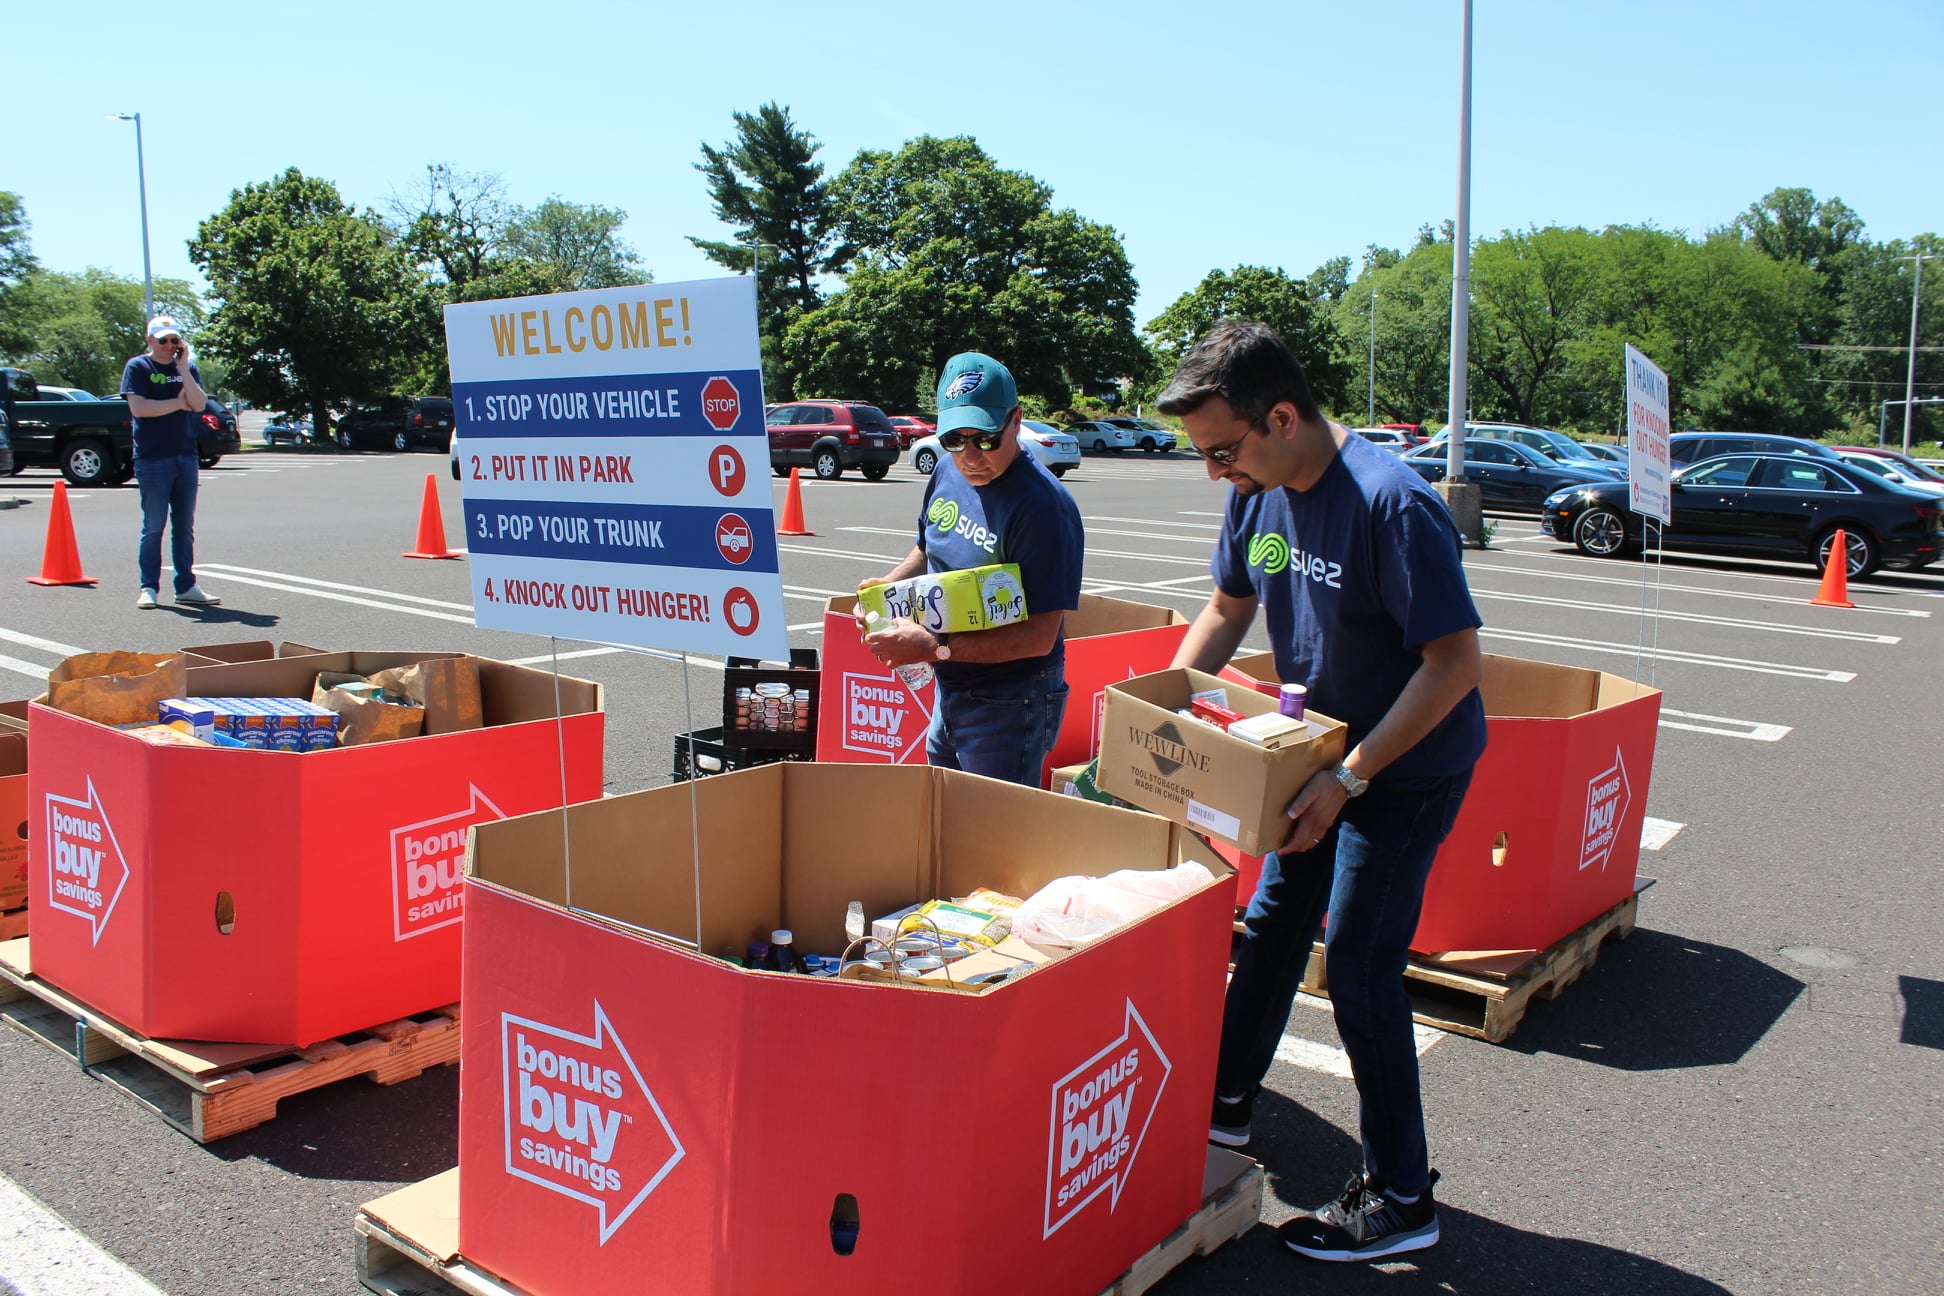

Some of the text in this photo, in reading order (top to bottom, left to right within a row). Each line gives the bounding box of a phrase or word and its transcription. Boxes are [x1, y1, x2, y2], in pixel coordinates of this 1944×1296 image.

[490, 297, 692, 357] WELCOME!
[166, 375, 183, 383] sue
[1632, 358, 1656, 401] THANK
[465, 389, 680, 421] 1. STOP YOUR VEHICLE
[706, 398, 736, 412] STOP
[1633, 401, 1645, 426] FOR
[1636, 429, 1648, 454] OUT
[471, 455, 634, 483] 2. PUT IT IN PARK
[718, 454, 735, 488] P
[477, 513, 664, 549] 3. POP YOUR TRUNK
[955, 514, 998, 554] suez
[1290, 546, 1342, 589] suez
[484, 577, 710, 623] 4. KNOCK OUT HUNGER!
[968, 615, 979, 625] 12
[850, 680, 905, 704] bonus
[850, 697, 905, 735] buy
[850, 729, 903, 749] savings
[1128, 725, 1212, 774] WEWLINE
[1131, 765, 1195, 799] TOOL STORAGE BOX
[1135, 777, 1185, 805] MADE IN CHINA
[1591, 776, 1620, 806] bonus
[53, 805, 101, 842] bonus
[1587, 796, 1619, 837] buy
[1585, 827, 1614, 855] savings
[54, 832, 102, 889] buy
[406, 853, 465, 900] bu
[56, 879, 103, 909] savings
[407, 891, 465, 922] savin
[516, 1032, 623, 1099] bonus
[1062, 1048, 1139, 1125] bonus
[519, 1069, 622, 1163] buy
[1060, 1080, 1137, 1178] buy
[520, 1137, 622, 1192] savings
[1057, 1134, 1131, 1208] savings
